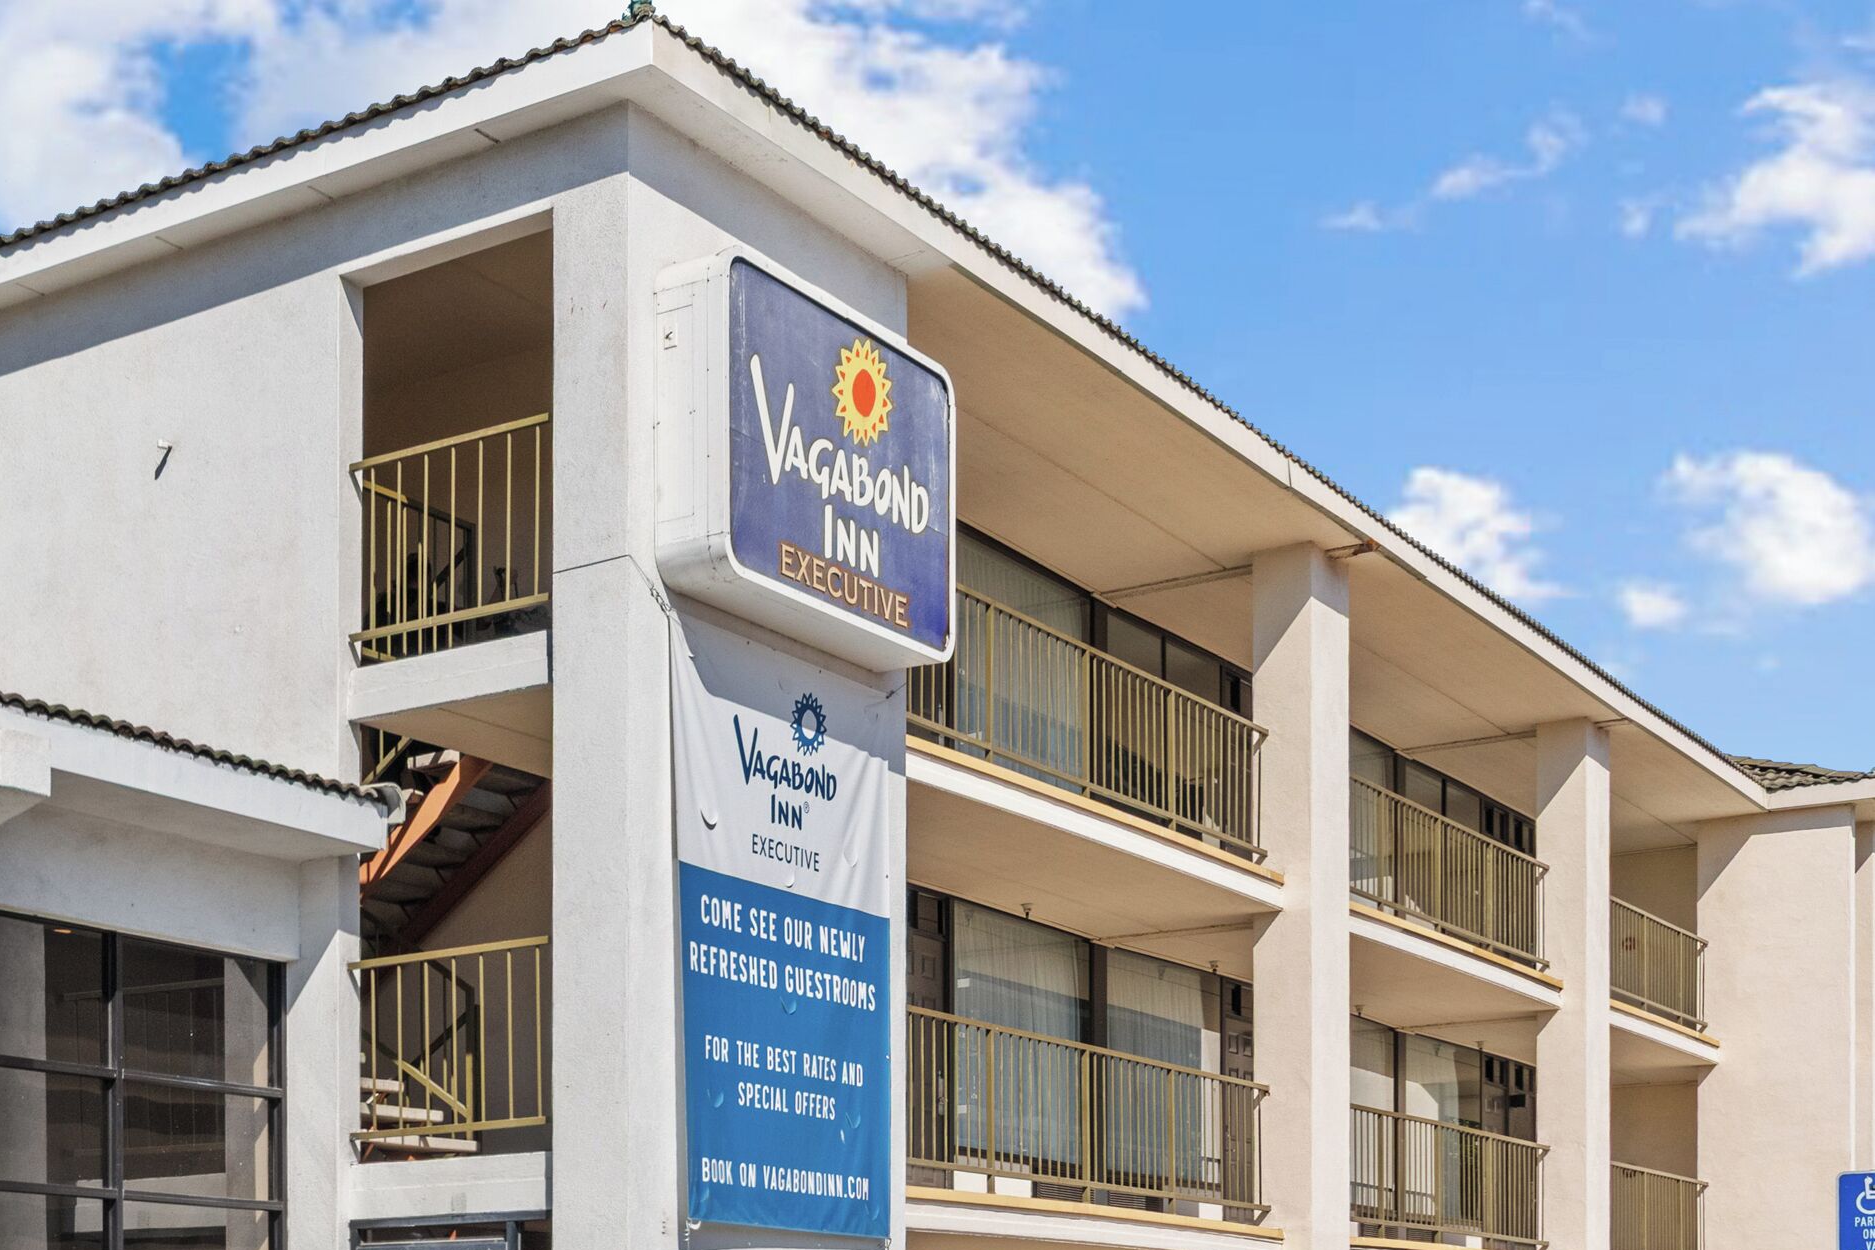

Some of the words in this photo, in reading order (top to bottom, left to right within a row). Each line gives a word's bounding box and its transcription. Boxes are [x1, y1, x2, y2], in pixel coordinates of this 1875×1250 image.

[750, 354, 930, 534] VAGABOND
[824, 503, 880, 578] INN
[780, 542, 909, 628] EXECUTIVE
[733, 713, 837, 801] VAGABOND
[751, 833, 820, 872] EXECUTIVE
[700, 894, 742, 933] COME
[749, 906, 777, 942] SEE
[783, 916, 813, 951] OUR
[819, 926, 866, 963] NEWLY
[689, 940, 778, 990] REFRESHED
[784, 964, 876, 1012] GUESTROOMS
[705, 1034, 729, 1063] FOR
[736, 1040, 760, 1069] THE
[766, 1046, 797, 1075] BEST
[803, 1053, 837, 1083] RATES
[841, 1059, 864, 1087] AND
[737, 1081, 789, 1113] SPECIAL
[794, 1090, 836, 1121] OFFERS
[701, 1157, 733, 1185] BOOK
[740, 1163, 757, 1188] ON
[763, 1165, 869, 1200] VAGABONDINN.COM
[1854, 1216, 1875, 1227] PAR
